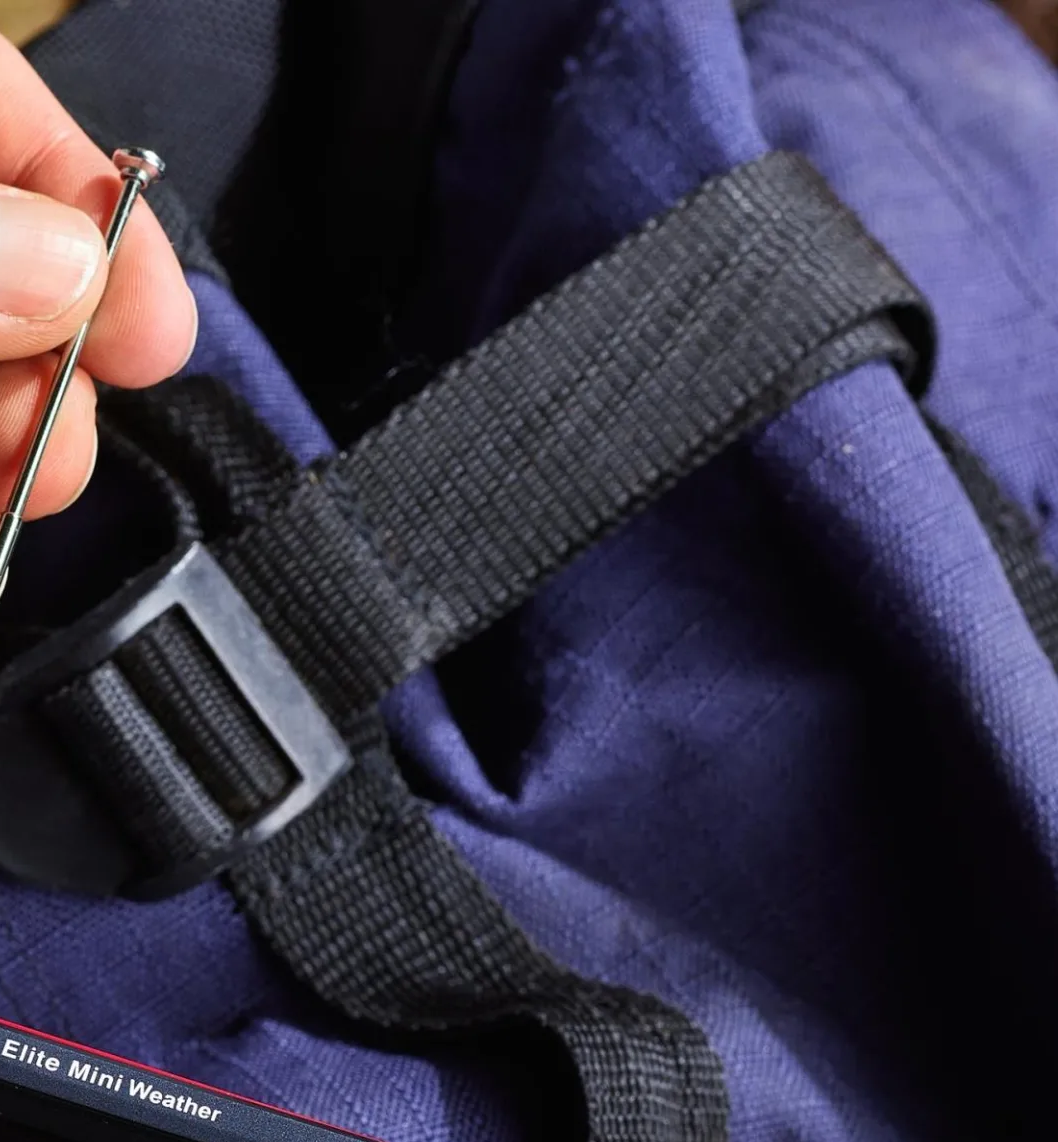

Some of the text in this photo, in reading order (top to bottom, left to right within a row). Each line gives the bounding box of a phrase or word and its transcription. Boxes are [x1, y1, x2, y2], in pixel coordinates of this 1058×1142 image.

[1, 1039, 223, 1122] Elite Mini Weather
